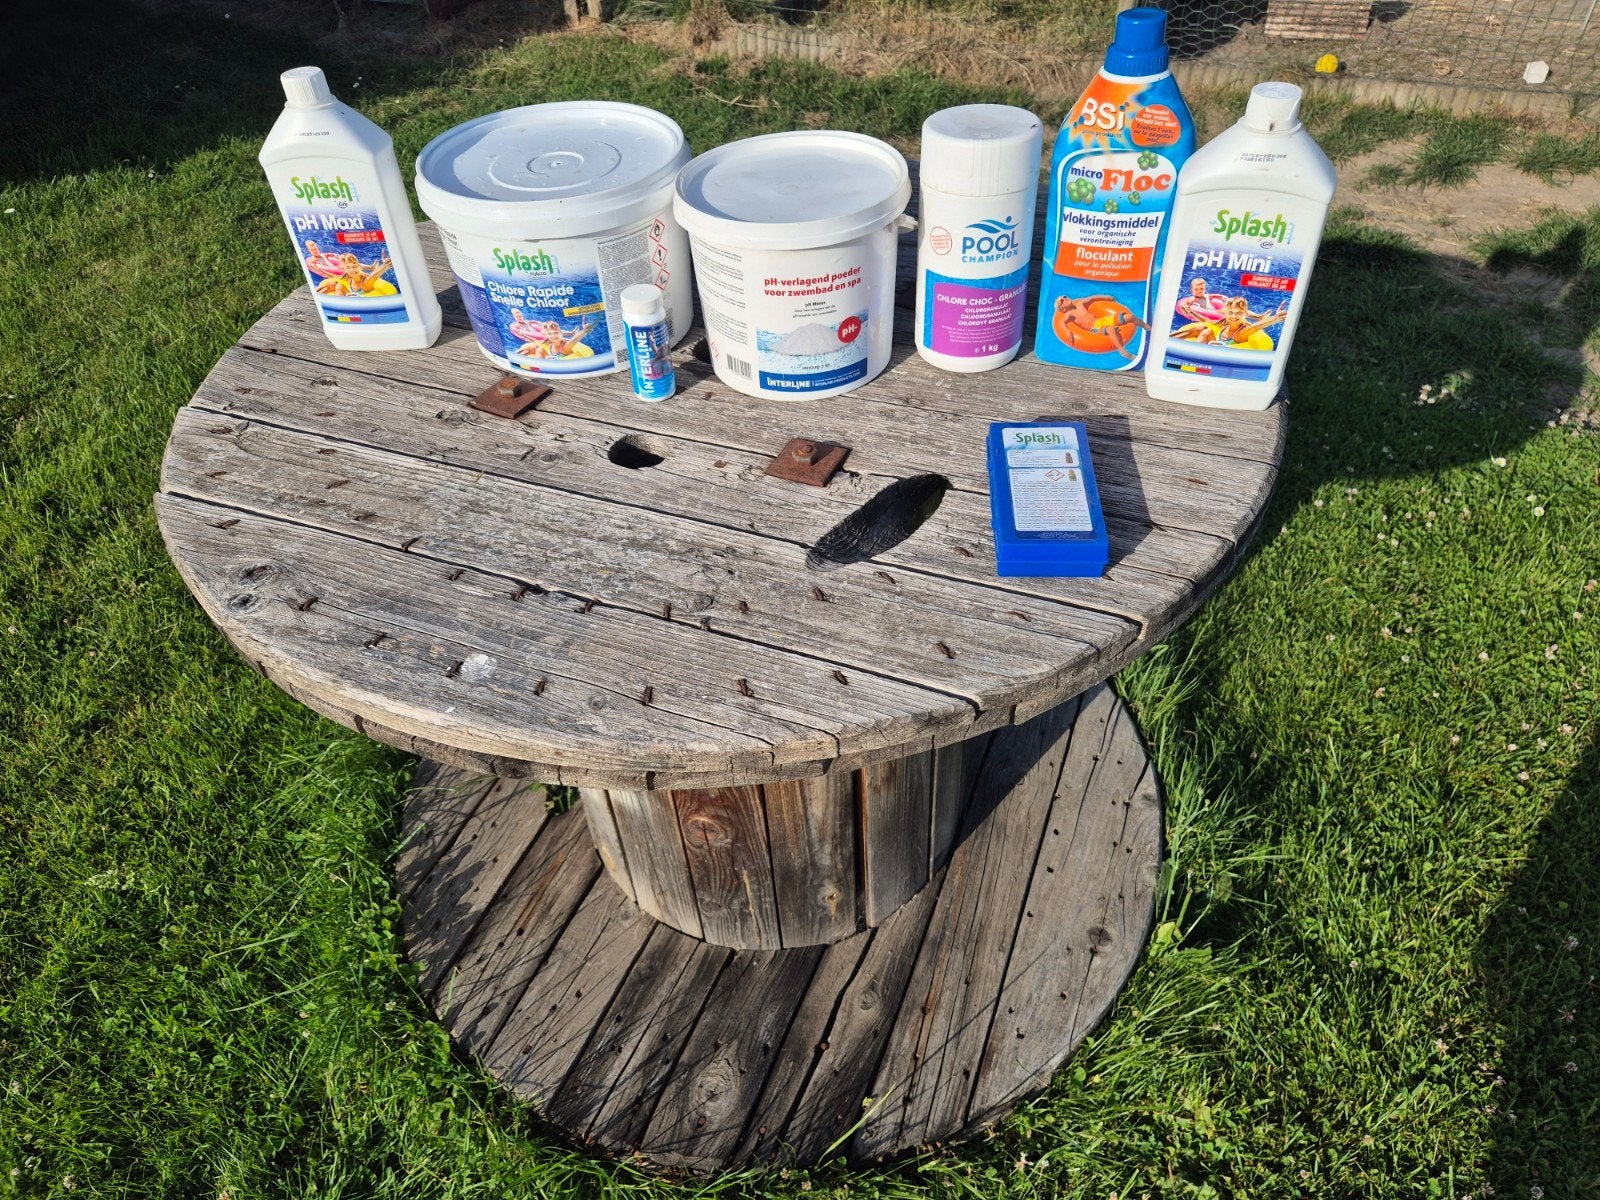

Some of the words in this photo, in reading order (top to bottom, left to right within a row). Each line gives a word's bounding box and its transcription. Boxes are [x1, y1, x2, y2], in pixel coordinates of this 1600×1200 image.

[1070, 166, 1103, 179] micro
[1100, 168, 1172, 192] Floc
[290, 176, 353, 205] Splash
[294, 214, 319, 233] pH
[320, 213, 365, 230] Maxi
[1063, 212, 1159, 230] vlokkingsmiddel
[1214, 209, 1288, 243] Splash
[962, 231, 1018, 254] POOL
[1080, 237, 1134, 246] verontreiniging
[493, 247, 554, 276] Splash
[962, 248, 1018, 263] CHAMPION
[1076, 247, 1134, 262] floculant
[1192, 250, 1224, 269] pH
[1228, 252, 1272, 273] Mini
[764, 274, 829, 286] pH-verlagend
[832, 266, 861, 282] poeder
[487, 280, 525, 297] Chlore
[527, 286, 574, 300] Rapide
[788, 284, 833, 296] zwembad
[835, 283, 845, 291] en
[848, 278, 861, 288] spa
[490, 292, 524, 307] Snelle
[526, 296, 570, 308] Chloor
[937, 293, 967, 305] CHLORE
[969, 297, 993, 306] CHOC
[635, 331, 655, 394] INTERLINE
[767, 376, 810, 389] INTERLINE
[1015, 432, 1061, 446] Splash
